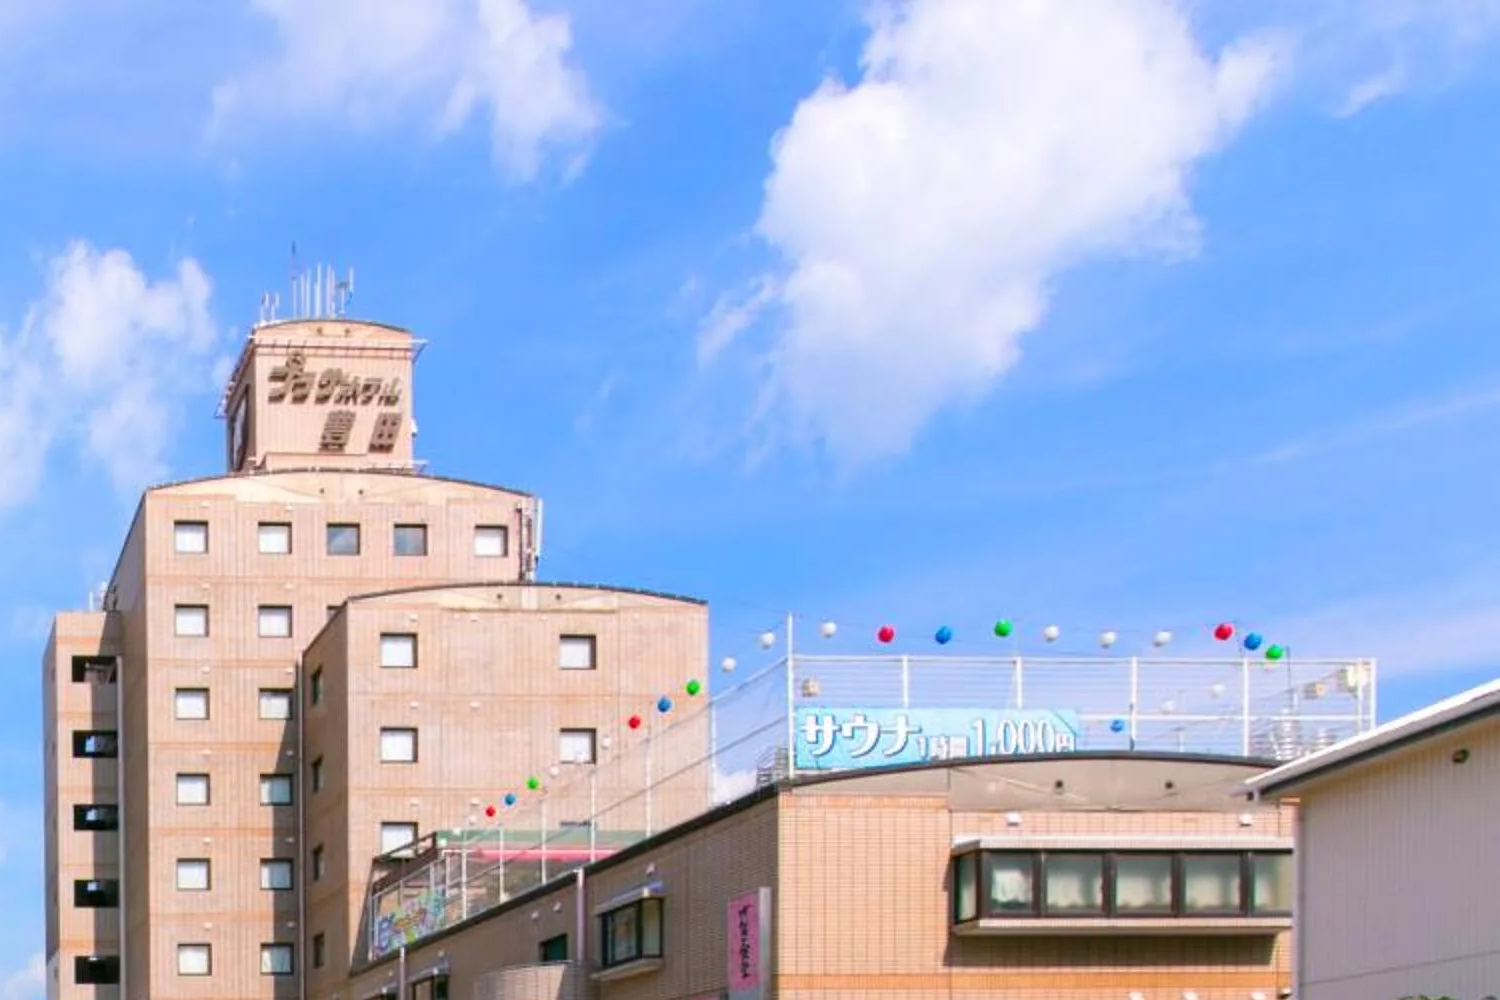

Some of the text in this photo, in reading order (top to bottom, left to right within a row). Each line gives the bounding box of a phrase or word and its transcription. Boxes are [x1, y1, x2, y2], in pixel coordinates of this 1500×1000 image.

[267, 350, 401, 406] プラザホテル
[319, 410, 402, 453] 豊田
[801, 713, 923, 759] サウナ
